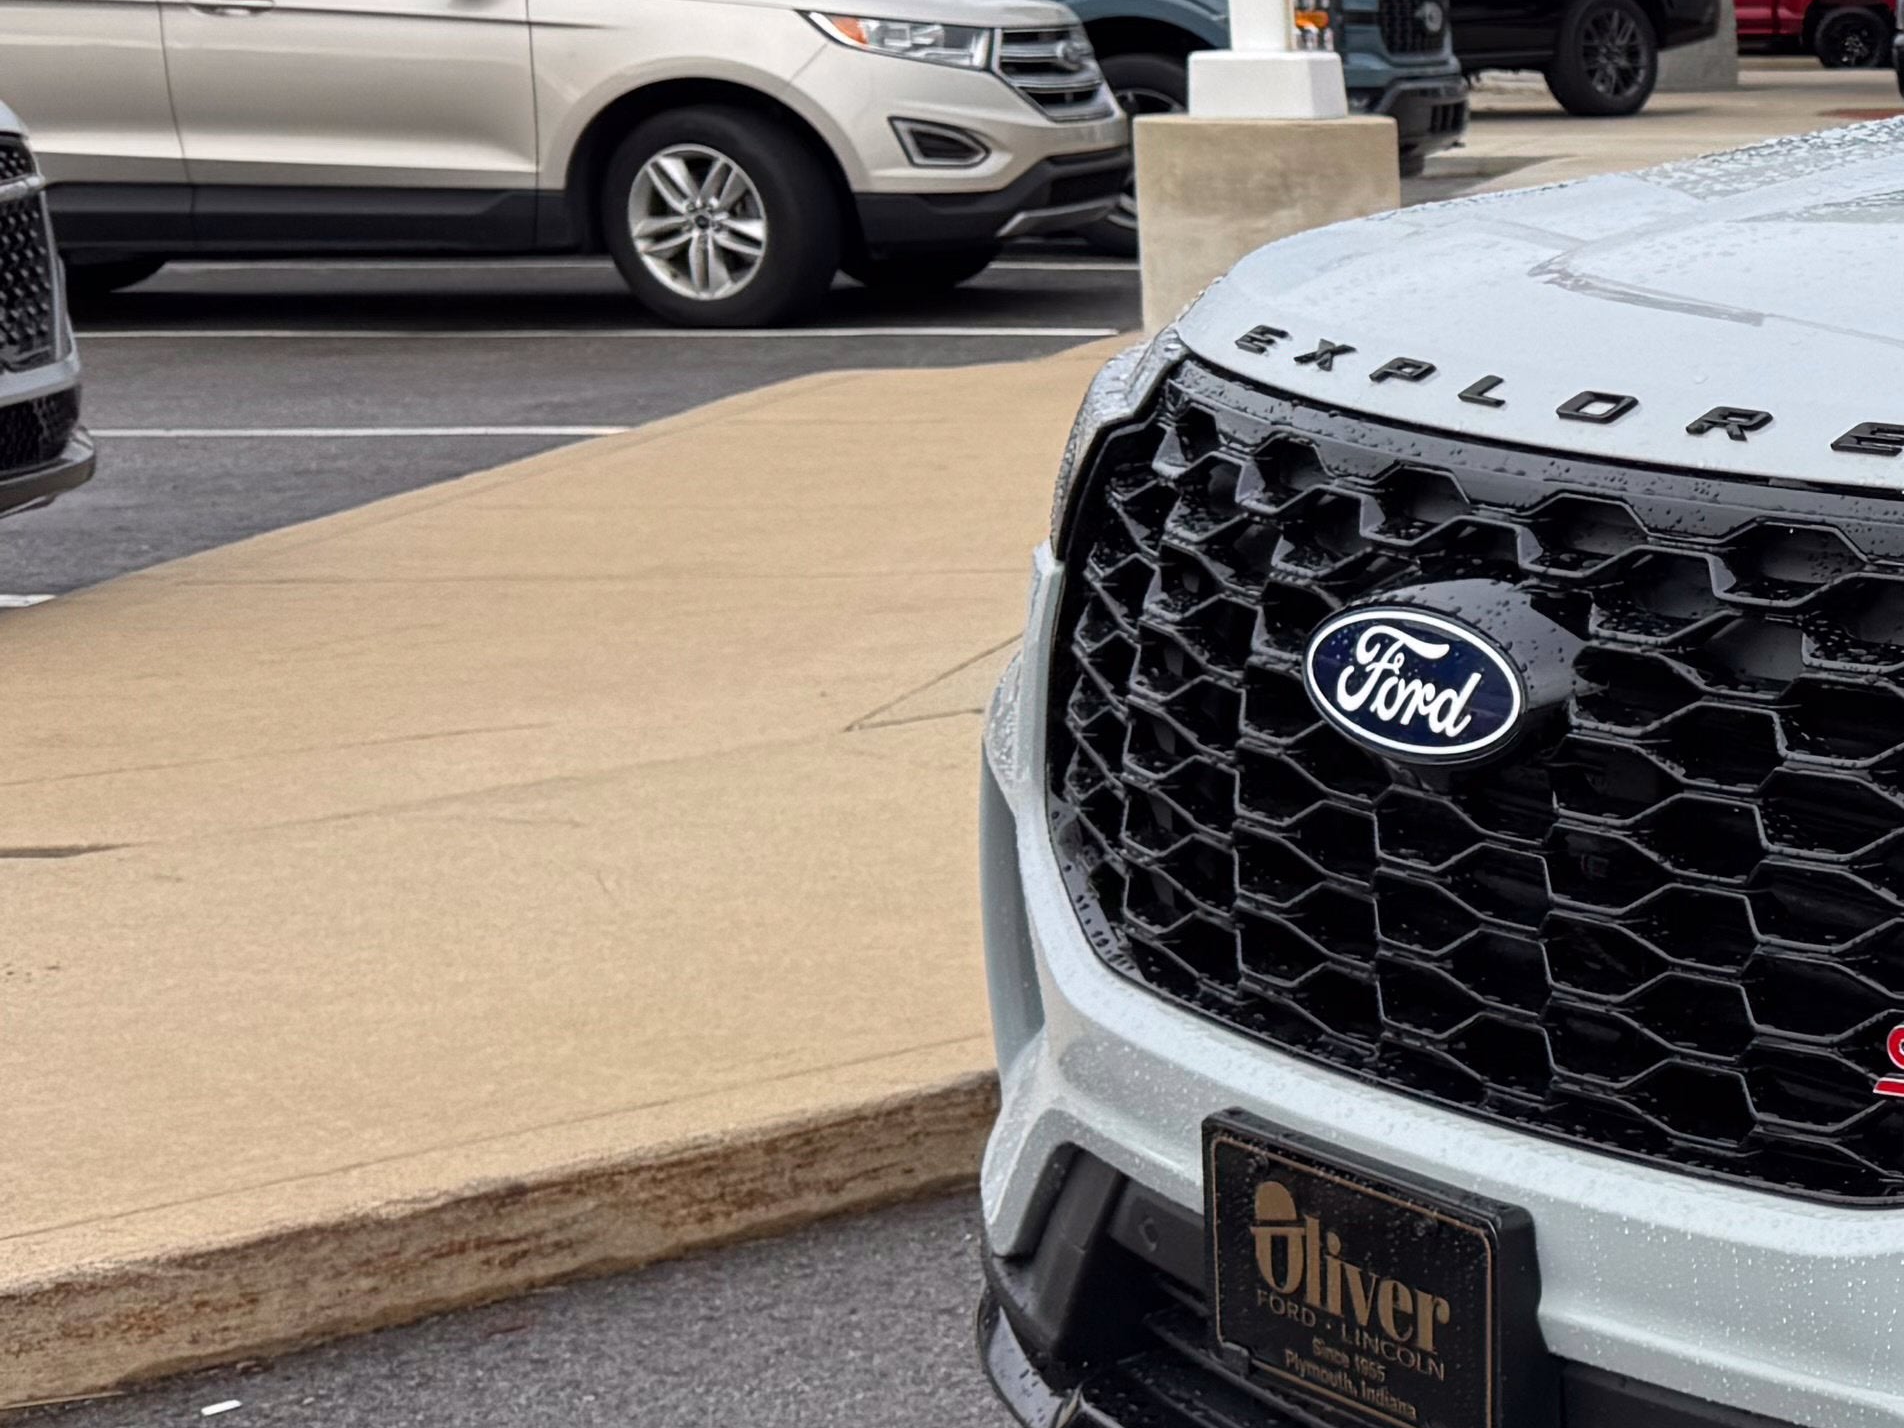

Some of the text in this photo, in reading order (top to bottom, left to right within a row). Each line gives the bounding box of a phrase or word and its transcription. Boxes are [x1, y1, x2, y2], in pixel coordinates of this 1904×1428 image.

[1336, 624, 1482, 738] Ford
[1250, 1180, 1451, 1356] Oliver
[1257, 1289, 1445, 1382] FORD LINCOLN
[1361, 1380, 1417, 1421] Indiana
